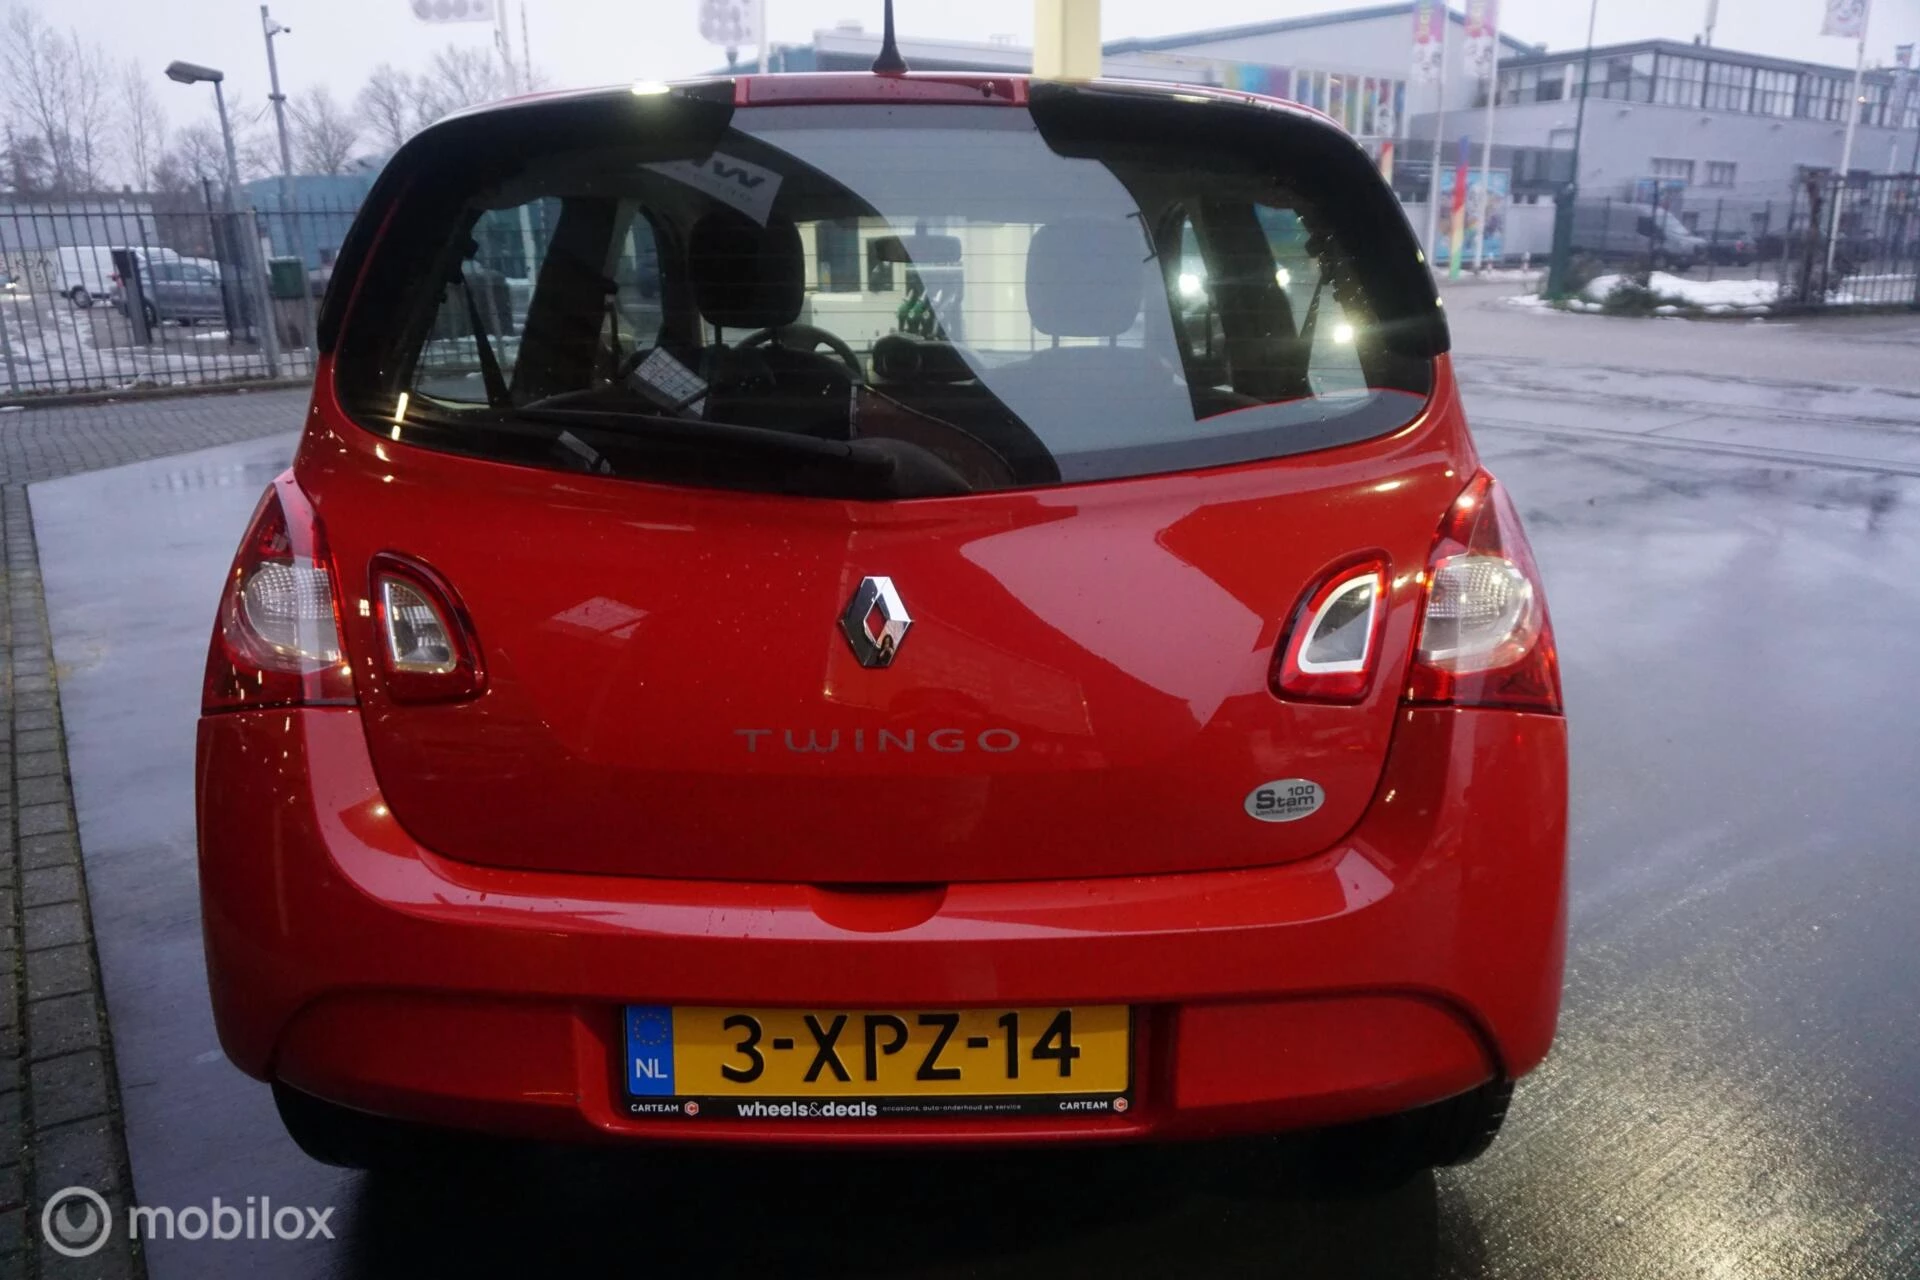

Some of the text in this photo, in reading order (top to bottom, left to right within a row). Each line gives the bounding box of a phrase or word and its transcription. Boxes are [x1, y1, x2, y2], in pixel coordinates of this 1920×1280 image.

[734, 728, 1021, 753] TWINGO
[1256, 789, 1315, 810] Stam
[1288, 785, 1315, 796] 100
[722, 1009, 1081, 1083] 3-XPZ-14
[636, 1058, 668, 1078] NL
[631, 1104, 679, 1112] CARTEAM
[737, 1101, 877, 1117] wheels&deals
[1059, 1101, 1108, 1110] CARTEAM
